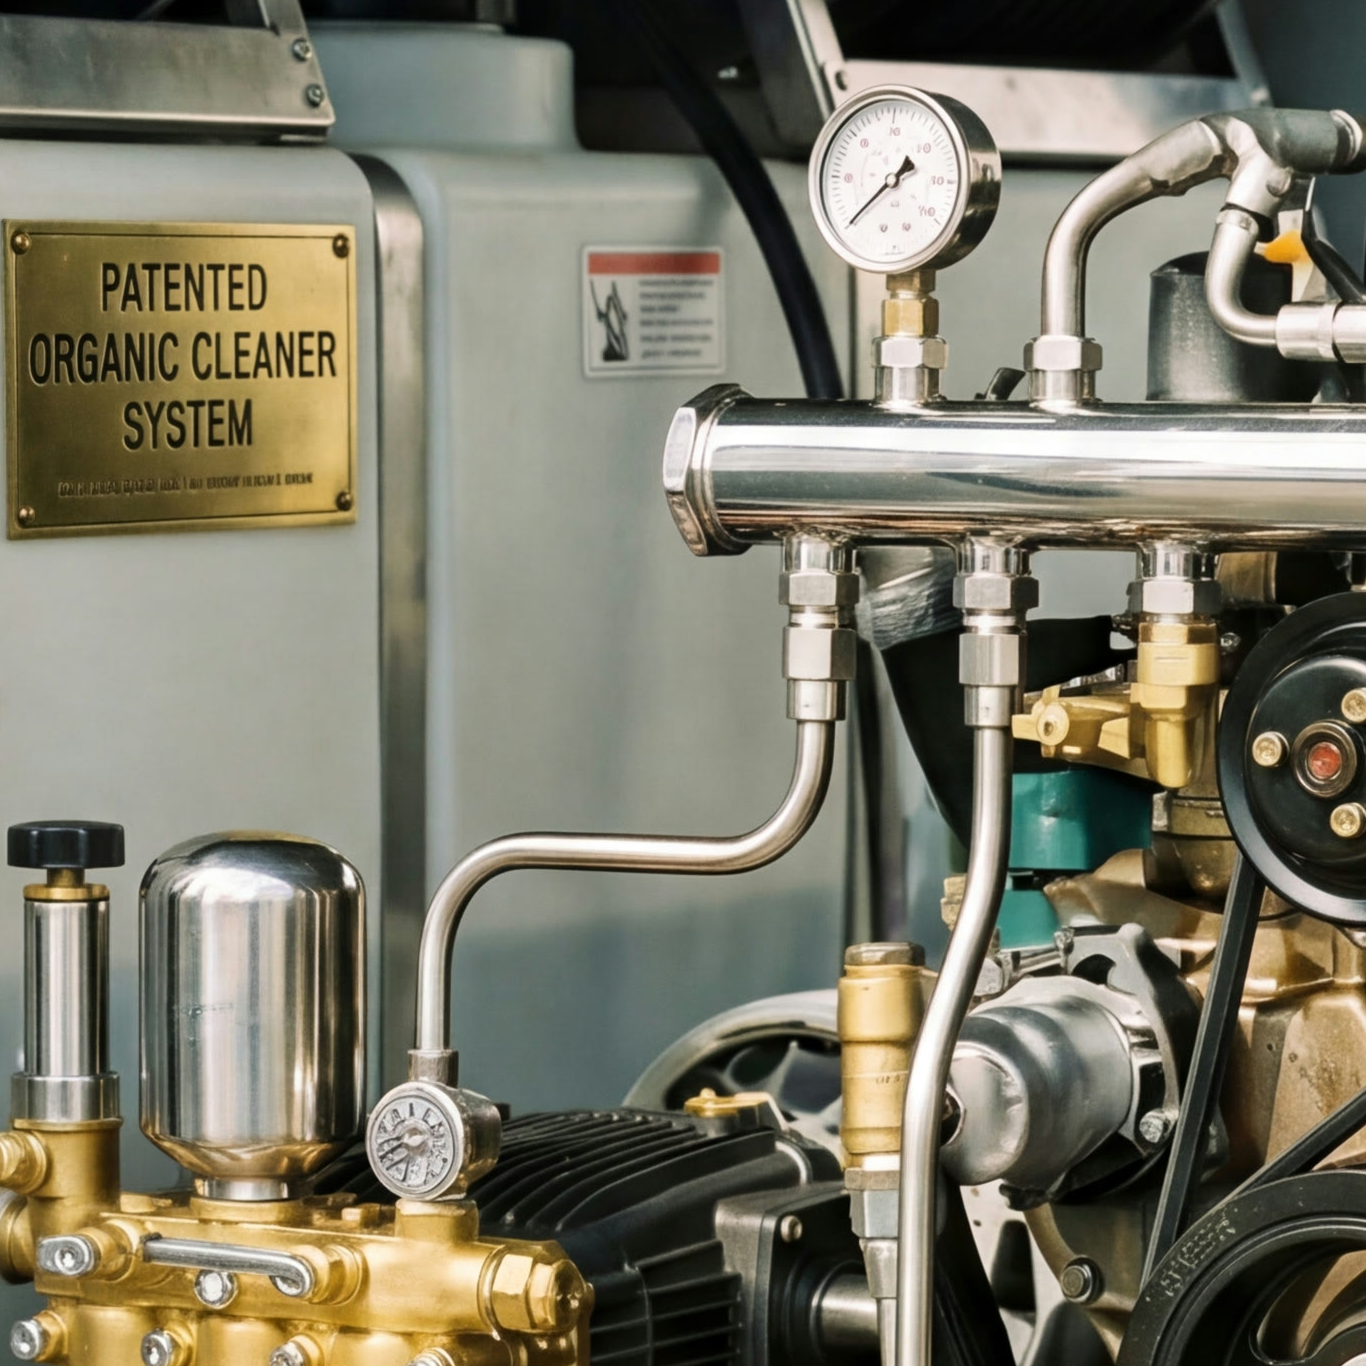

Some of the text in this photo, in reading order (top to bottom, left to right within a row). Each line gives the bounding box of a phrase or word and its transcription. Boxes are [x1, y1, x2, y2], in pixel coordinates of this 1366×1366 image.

[101, 262, 268, 312] PATENTED
[29, 331, 338, 384] ORGANIC CLEANER
[122, 398, 254, 450] SYSTEM
